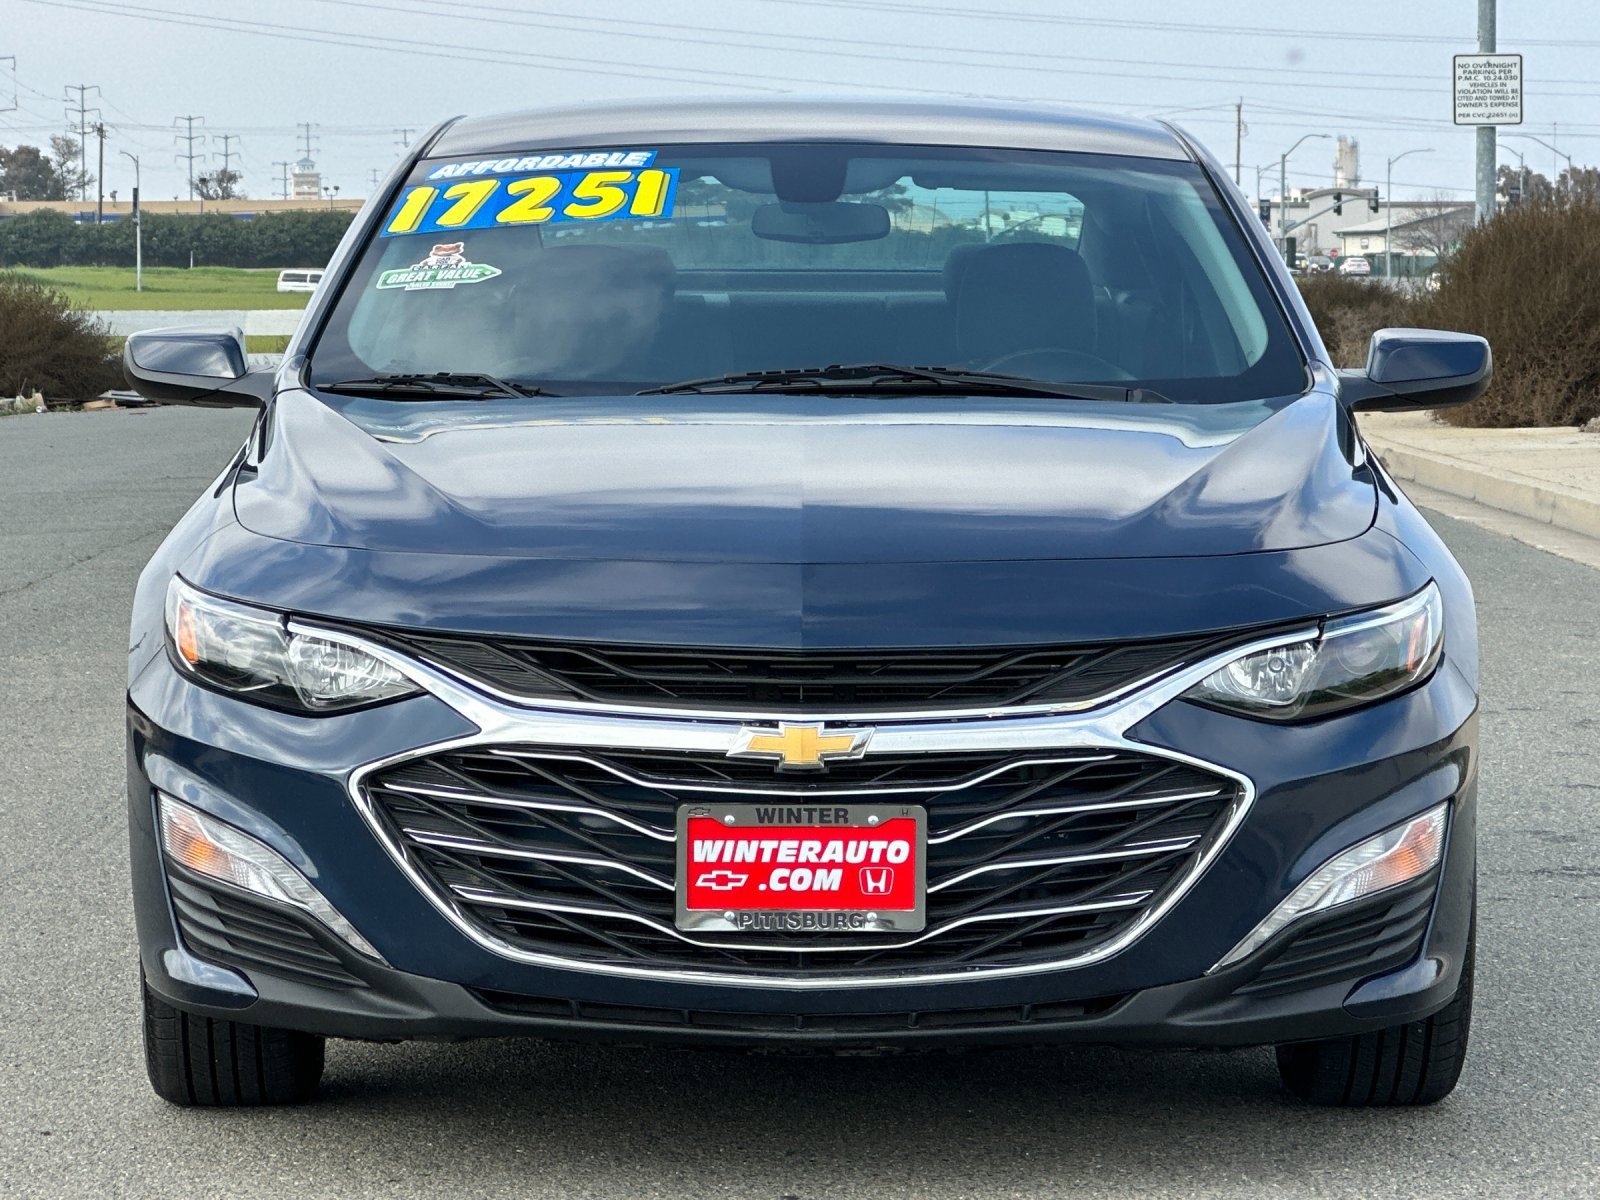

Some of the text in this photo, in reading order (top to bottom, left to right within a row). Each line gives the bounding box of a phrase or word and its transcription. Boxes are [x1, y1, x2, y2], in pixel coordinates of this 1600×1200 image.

[428, 152, 652, 180] AFFORDABLE
[387, 170, 671, 233] 17251
[386, 269, 481, 284] GREAT VALUE
[755, 807, 849, 824] WINTER
[693, 839, 910, 864] WINTERAUTO
[758, 868, 843, 891] .COM
[739, 912, 866, 930] PITTSBURG
